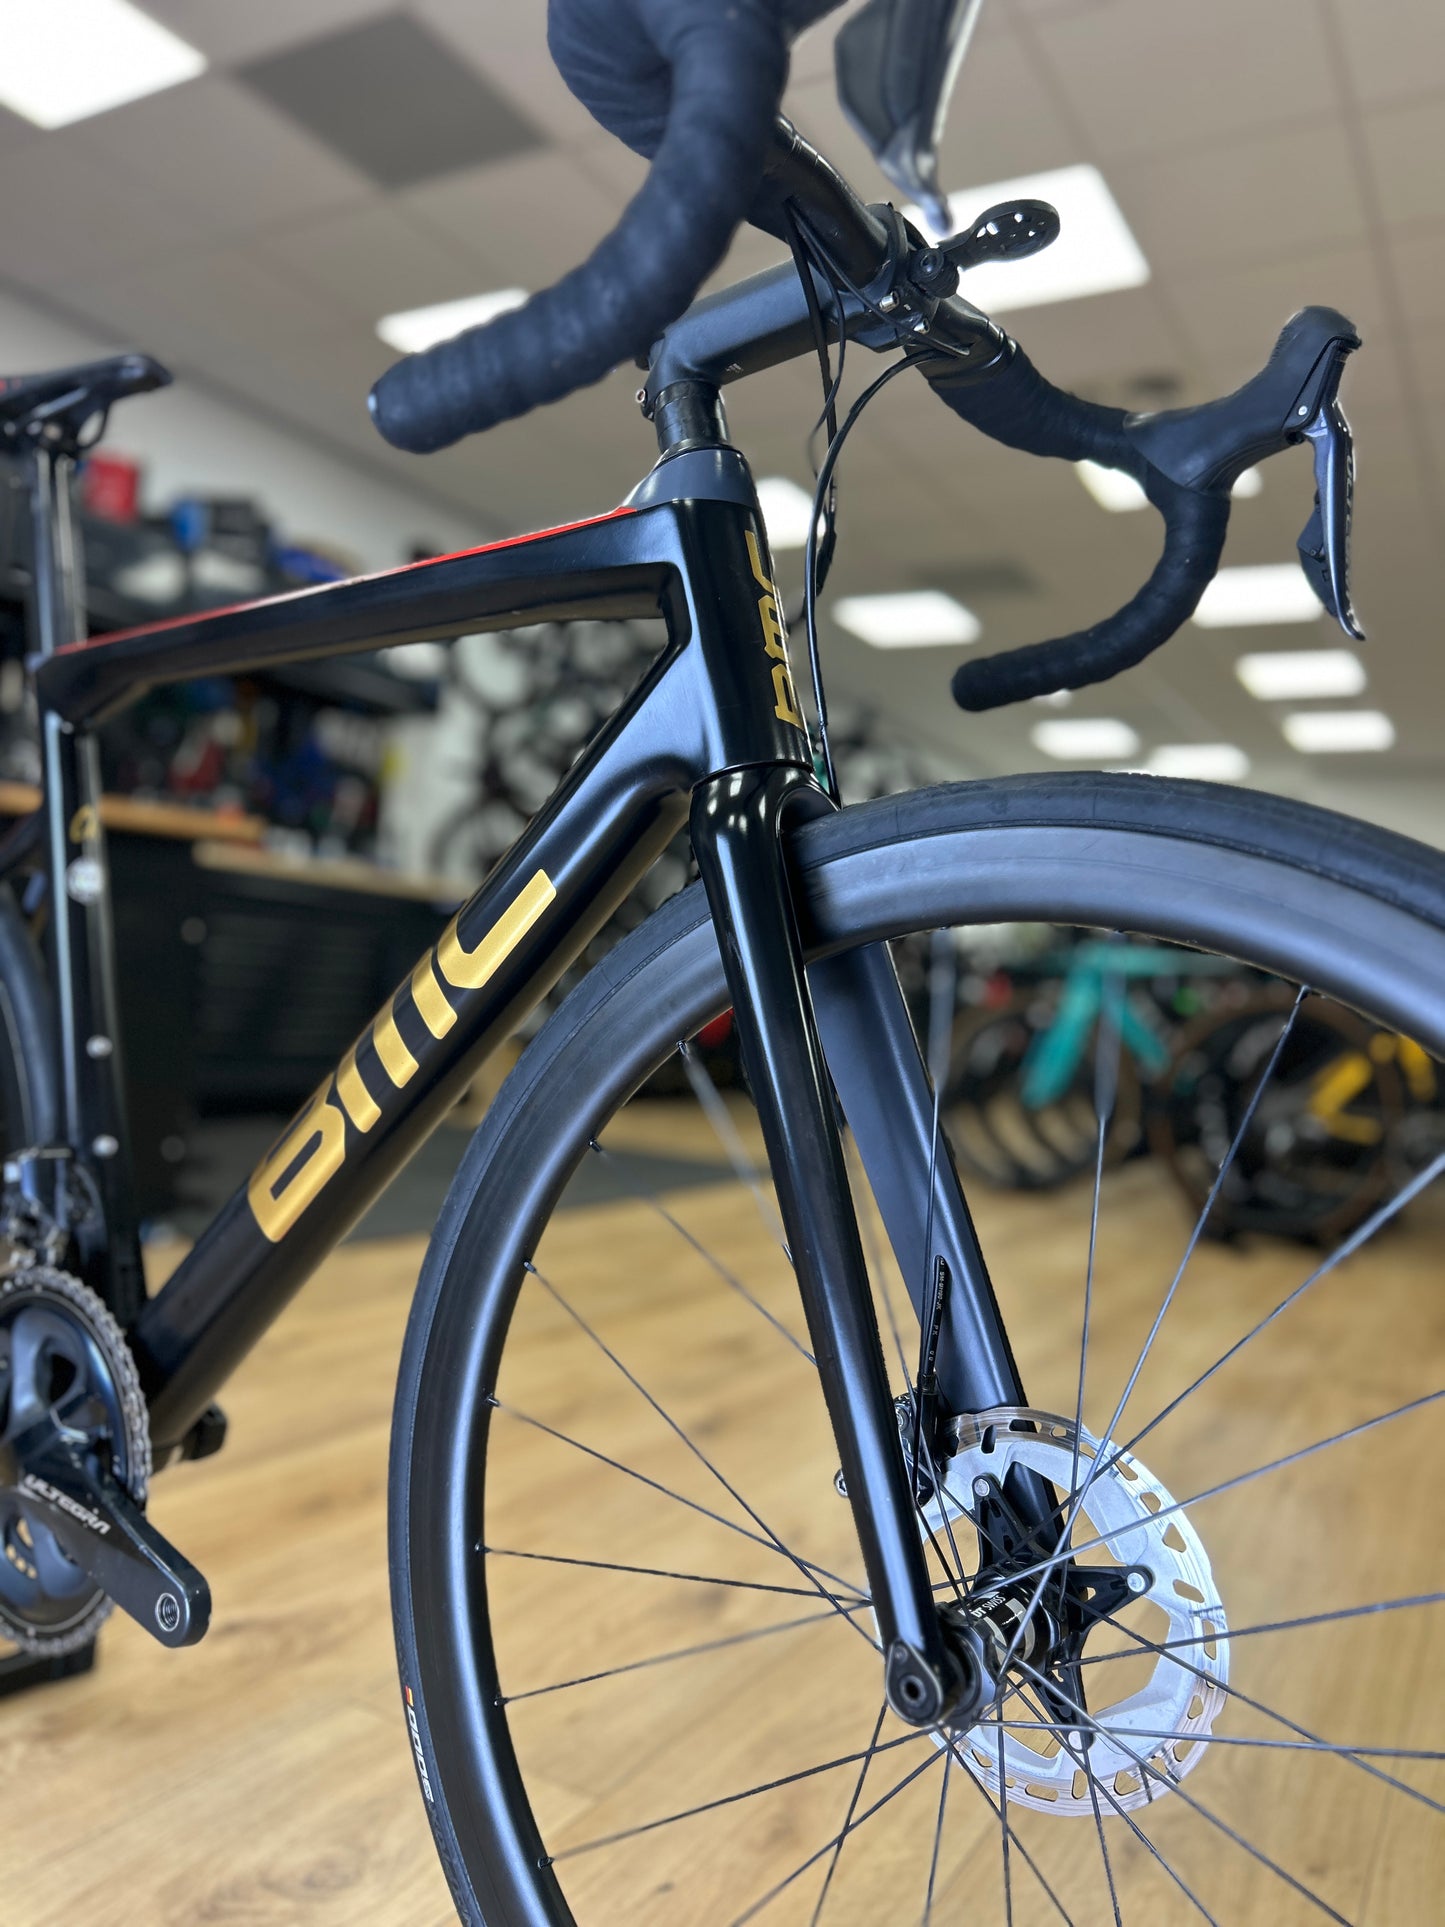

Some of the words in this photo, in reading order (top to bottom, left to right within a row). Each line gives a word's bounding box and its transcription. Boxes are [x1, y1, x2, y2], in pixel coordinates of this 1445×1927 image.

[248, 869, 557, 1243] BMC
[24, 1473, 111, 1534] ULTEGRA
[981, 1594, 1006, 1611] SWISS
